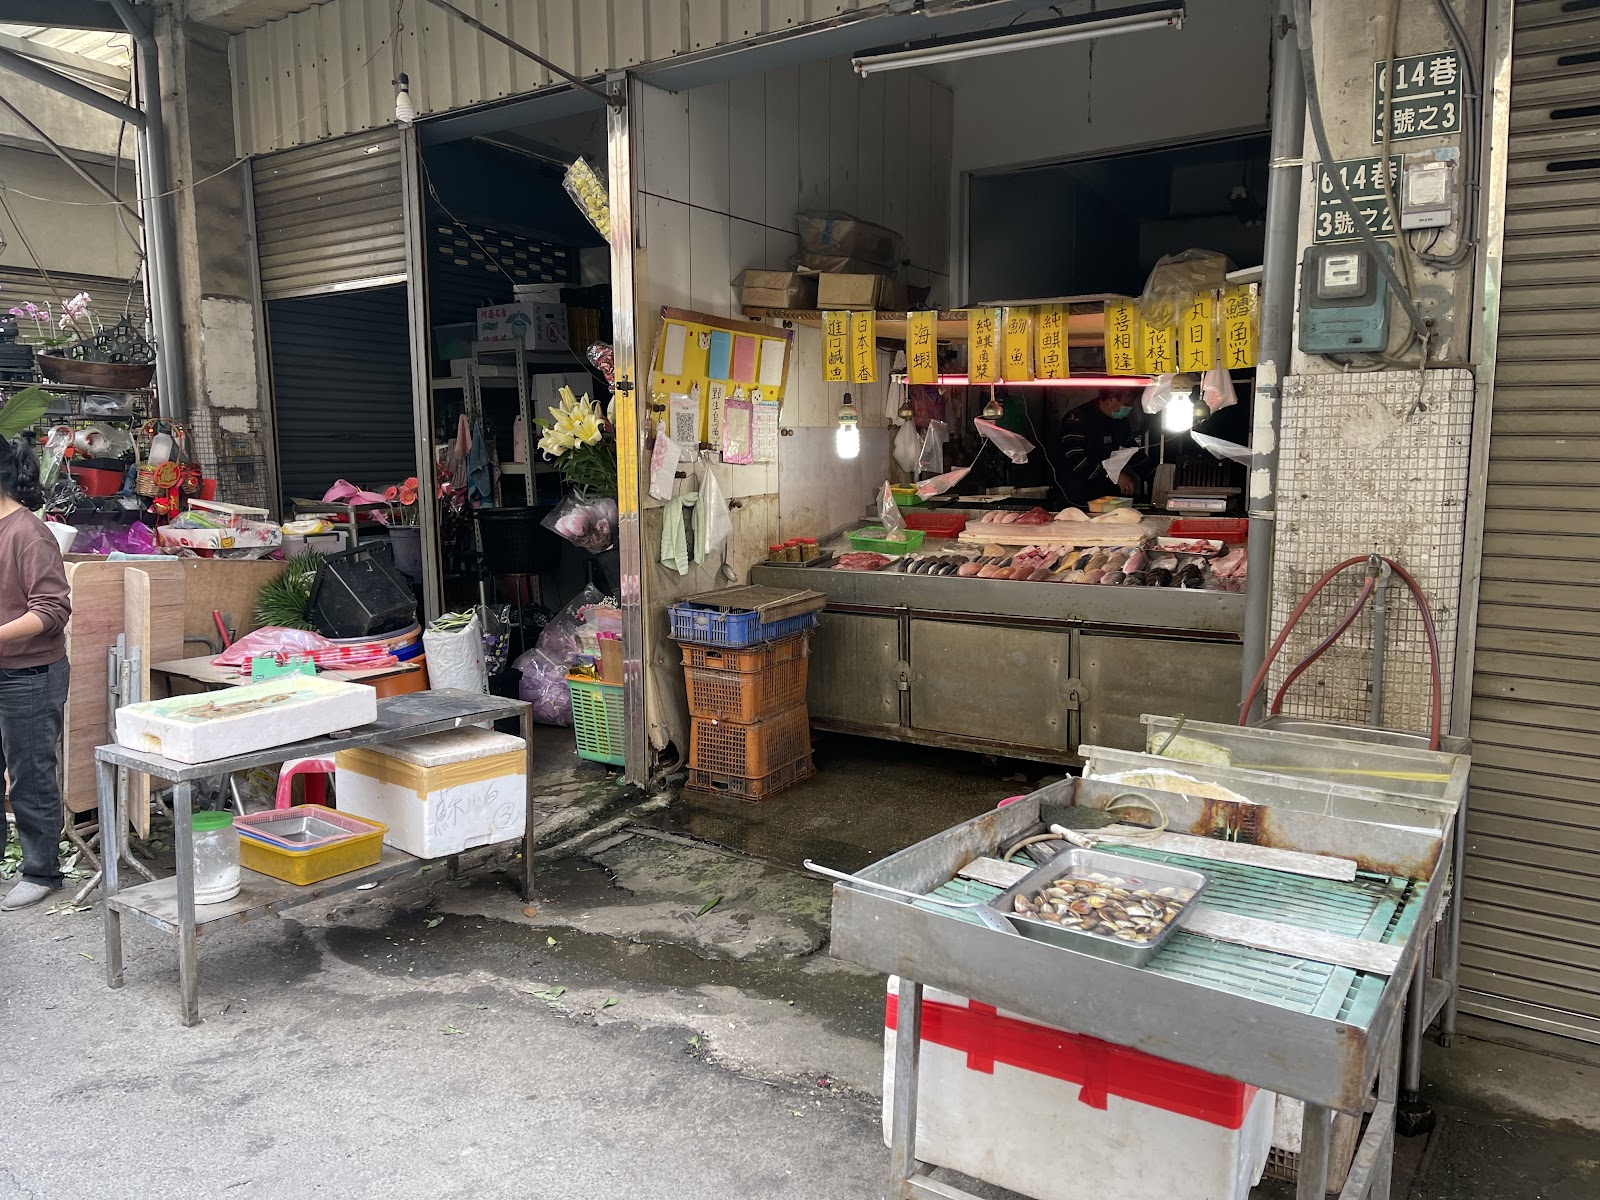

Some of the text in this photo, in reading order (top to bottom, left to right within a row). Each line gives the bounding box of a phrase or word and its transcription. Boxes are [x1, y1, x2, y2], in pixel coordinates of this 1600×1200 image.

[1321, 161, 1397, 194] 614巷
[855, 319, 872, 381] 日本丁香
[912, 323, 932, 370] 海蝦
[1112, 306, 1135, 371] 喜相逢
[1225, 293, 1250, 368] 鱈魚丸
